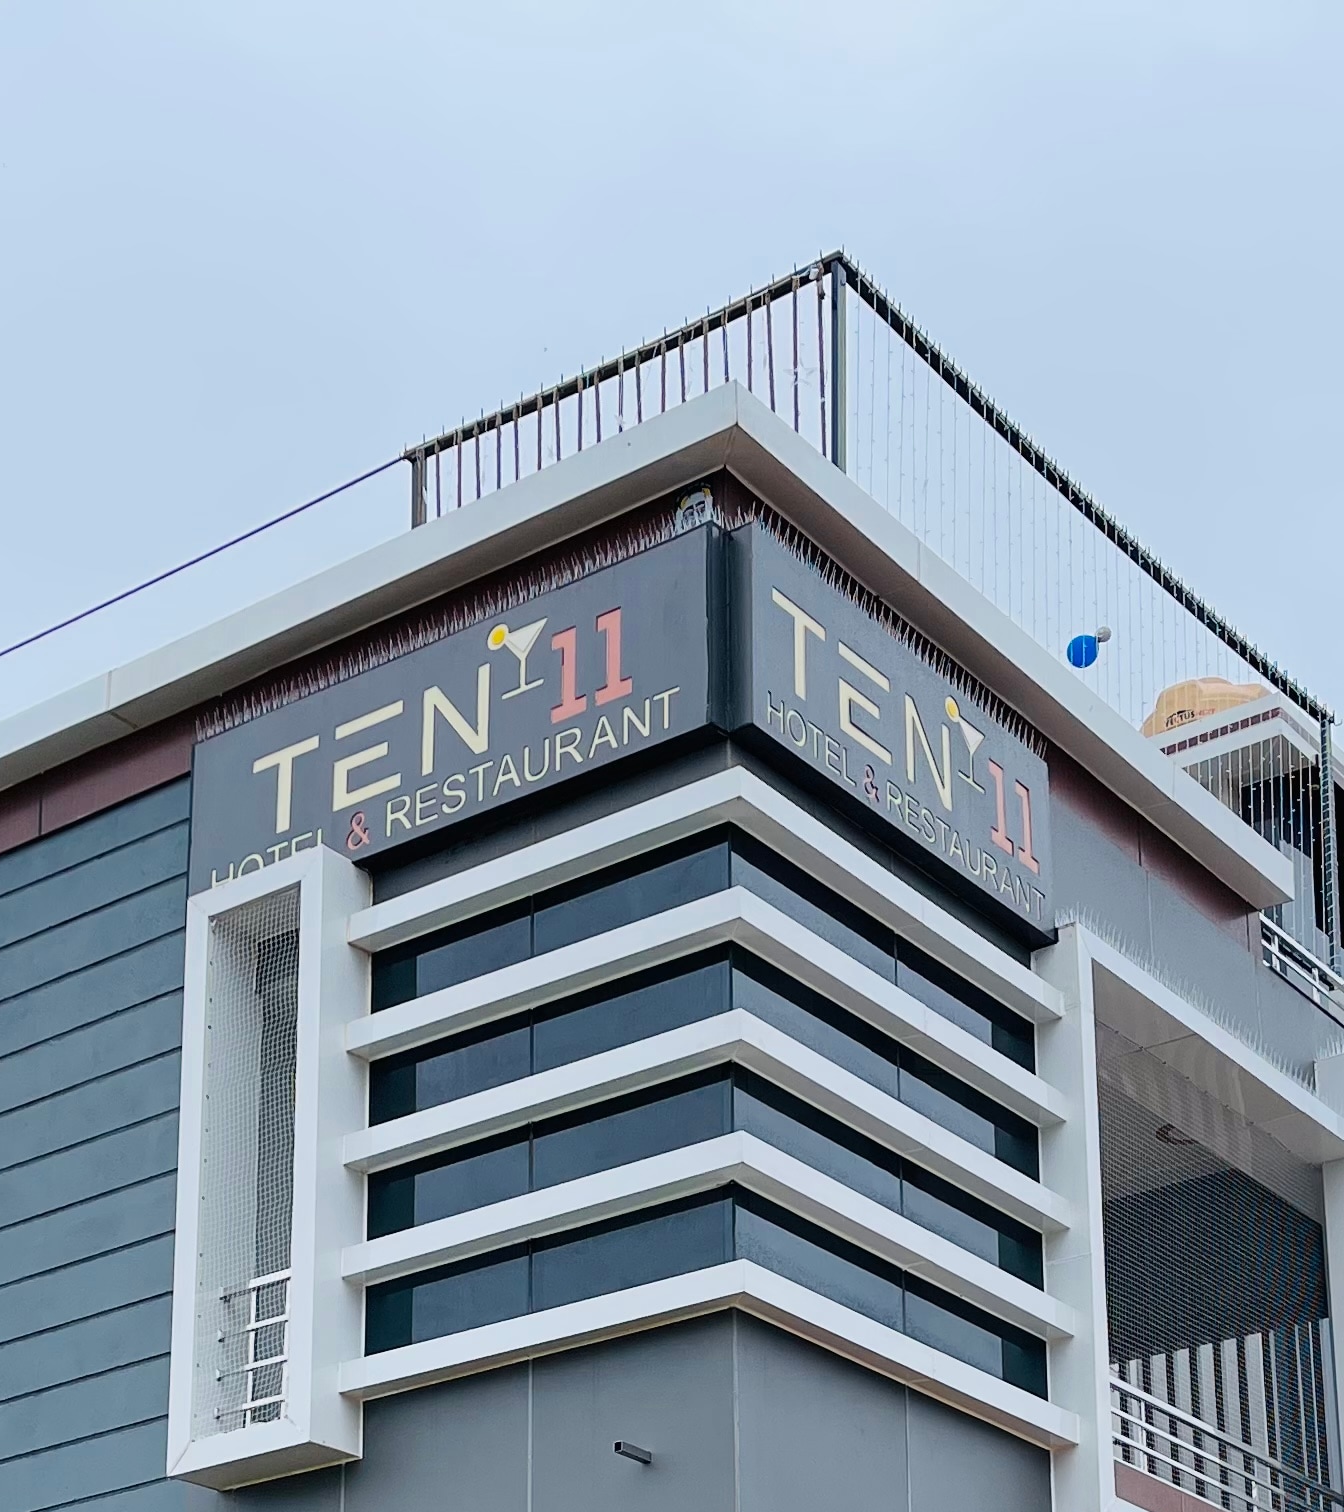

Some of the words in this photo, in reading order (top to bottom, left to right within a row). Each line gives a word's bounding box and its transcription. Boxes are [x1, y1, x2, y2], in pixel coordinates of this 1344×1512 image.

[252, 662, 492, 835] TEN
[550, 606, 634, 724] 11
[346, 810, 370, 851] &
[385, 687, 681, 838] RESTAURANT
[766, 690, 858, 788] HOTEL
[862, 763, 881, 803] &
[886, 779, 1046, 922] RESTAURANT
[771, 585, 953, 812] TEN
[988, 757, 1040, 876] 11
